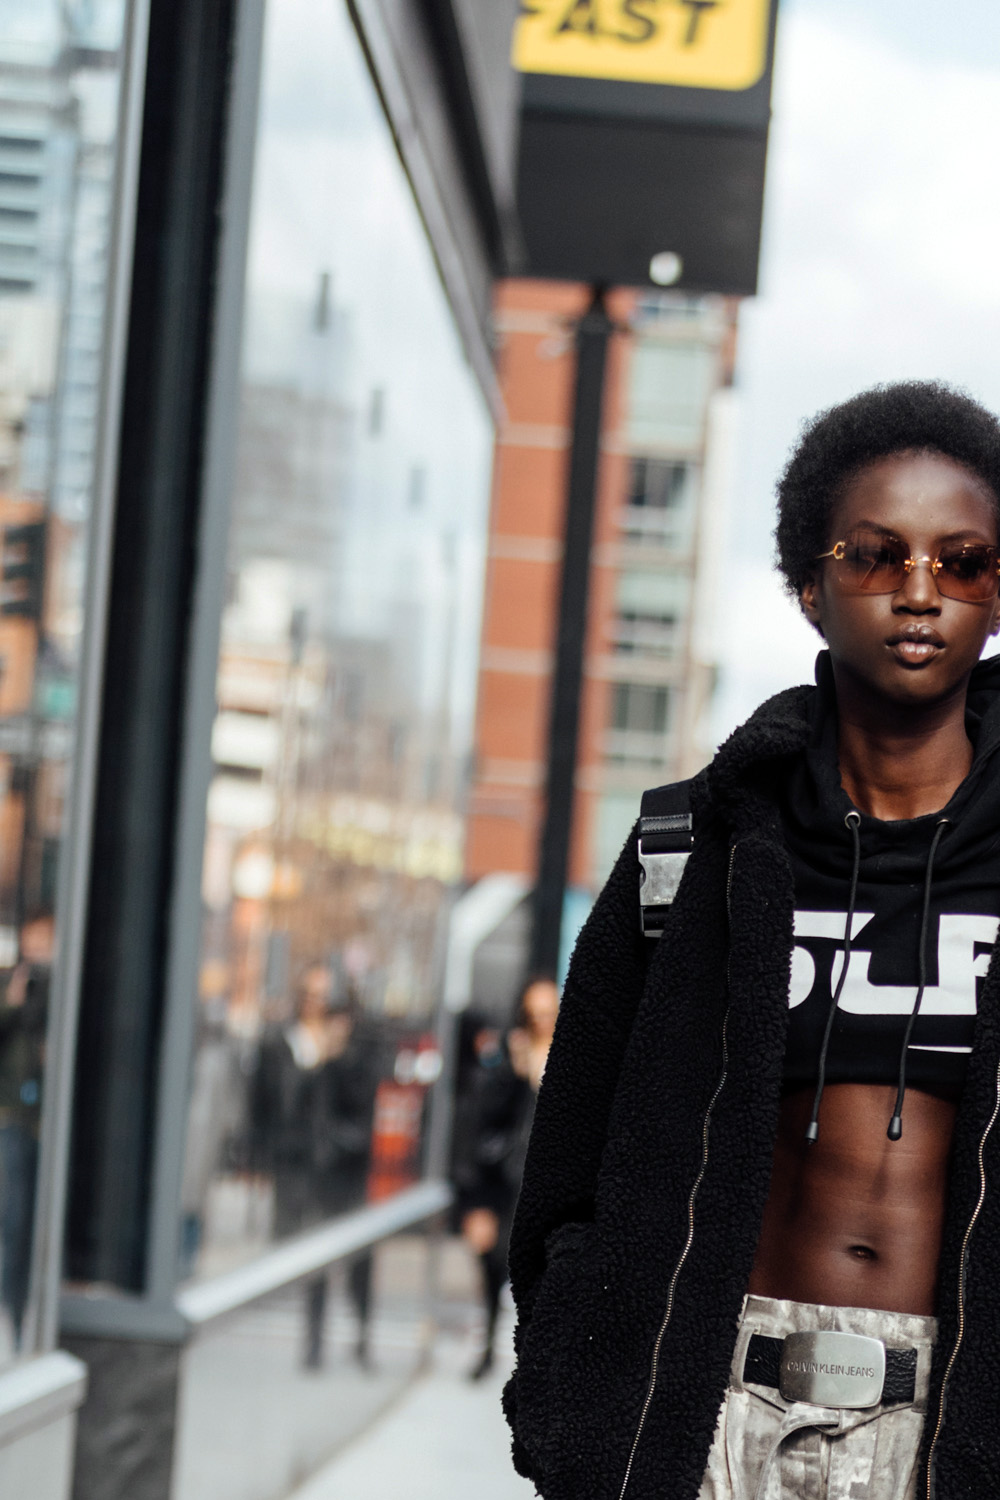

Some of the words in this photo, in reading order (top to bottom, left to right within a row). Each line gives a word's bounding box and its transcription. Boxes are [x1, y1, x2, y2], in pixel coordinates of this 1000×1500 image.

[518, 0, 717, 45] AST
[787, 1361, 818, 1373] CALVIN
[819, 1363, 845, 1375] KLEIN
[845, 1366, 875, 1378] JEANS
